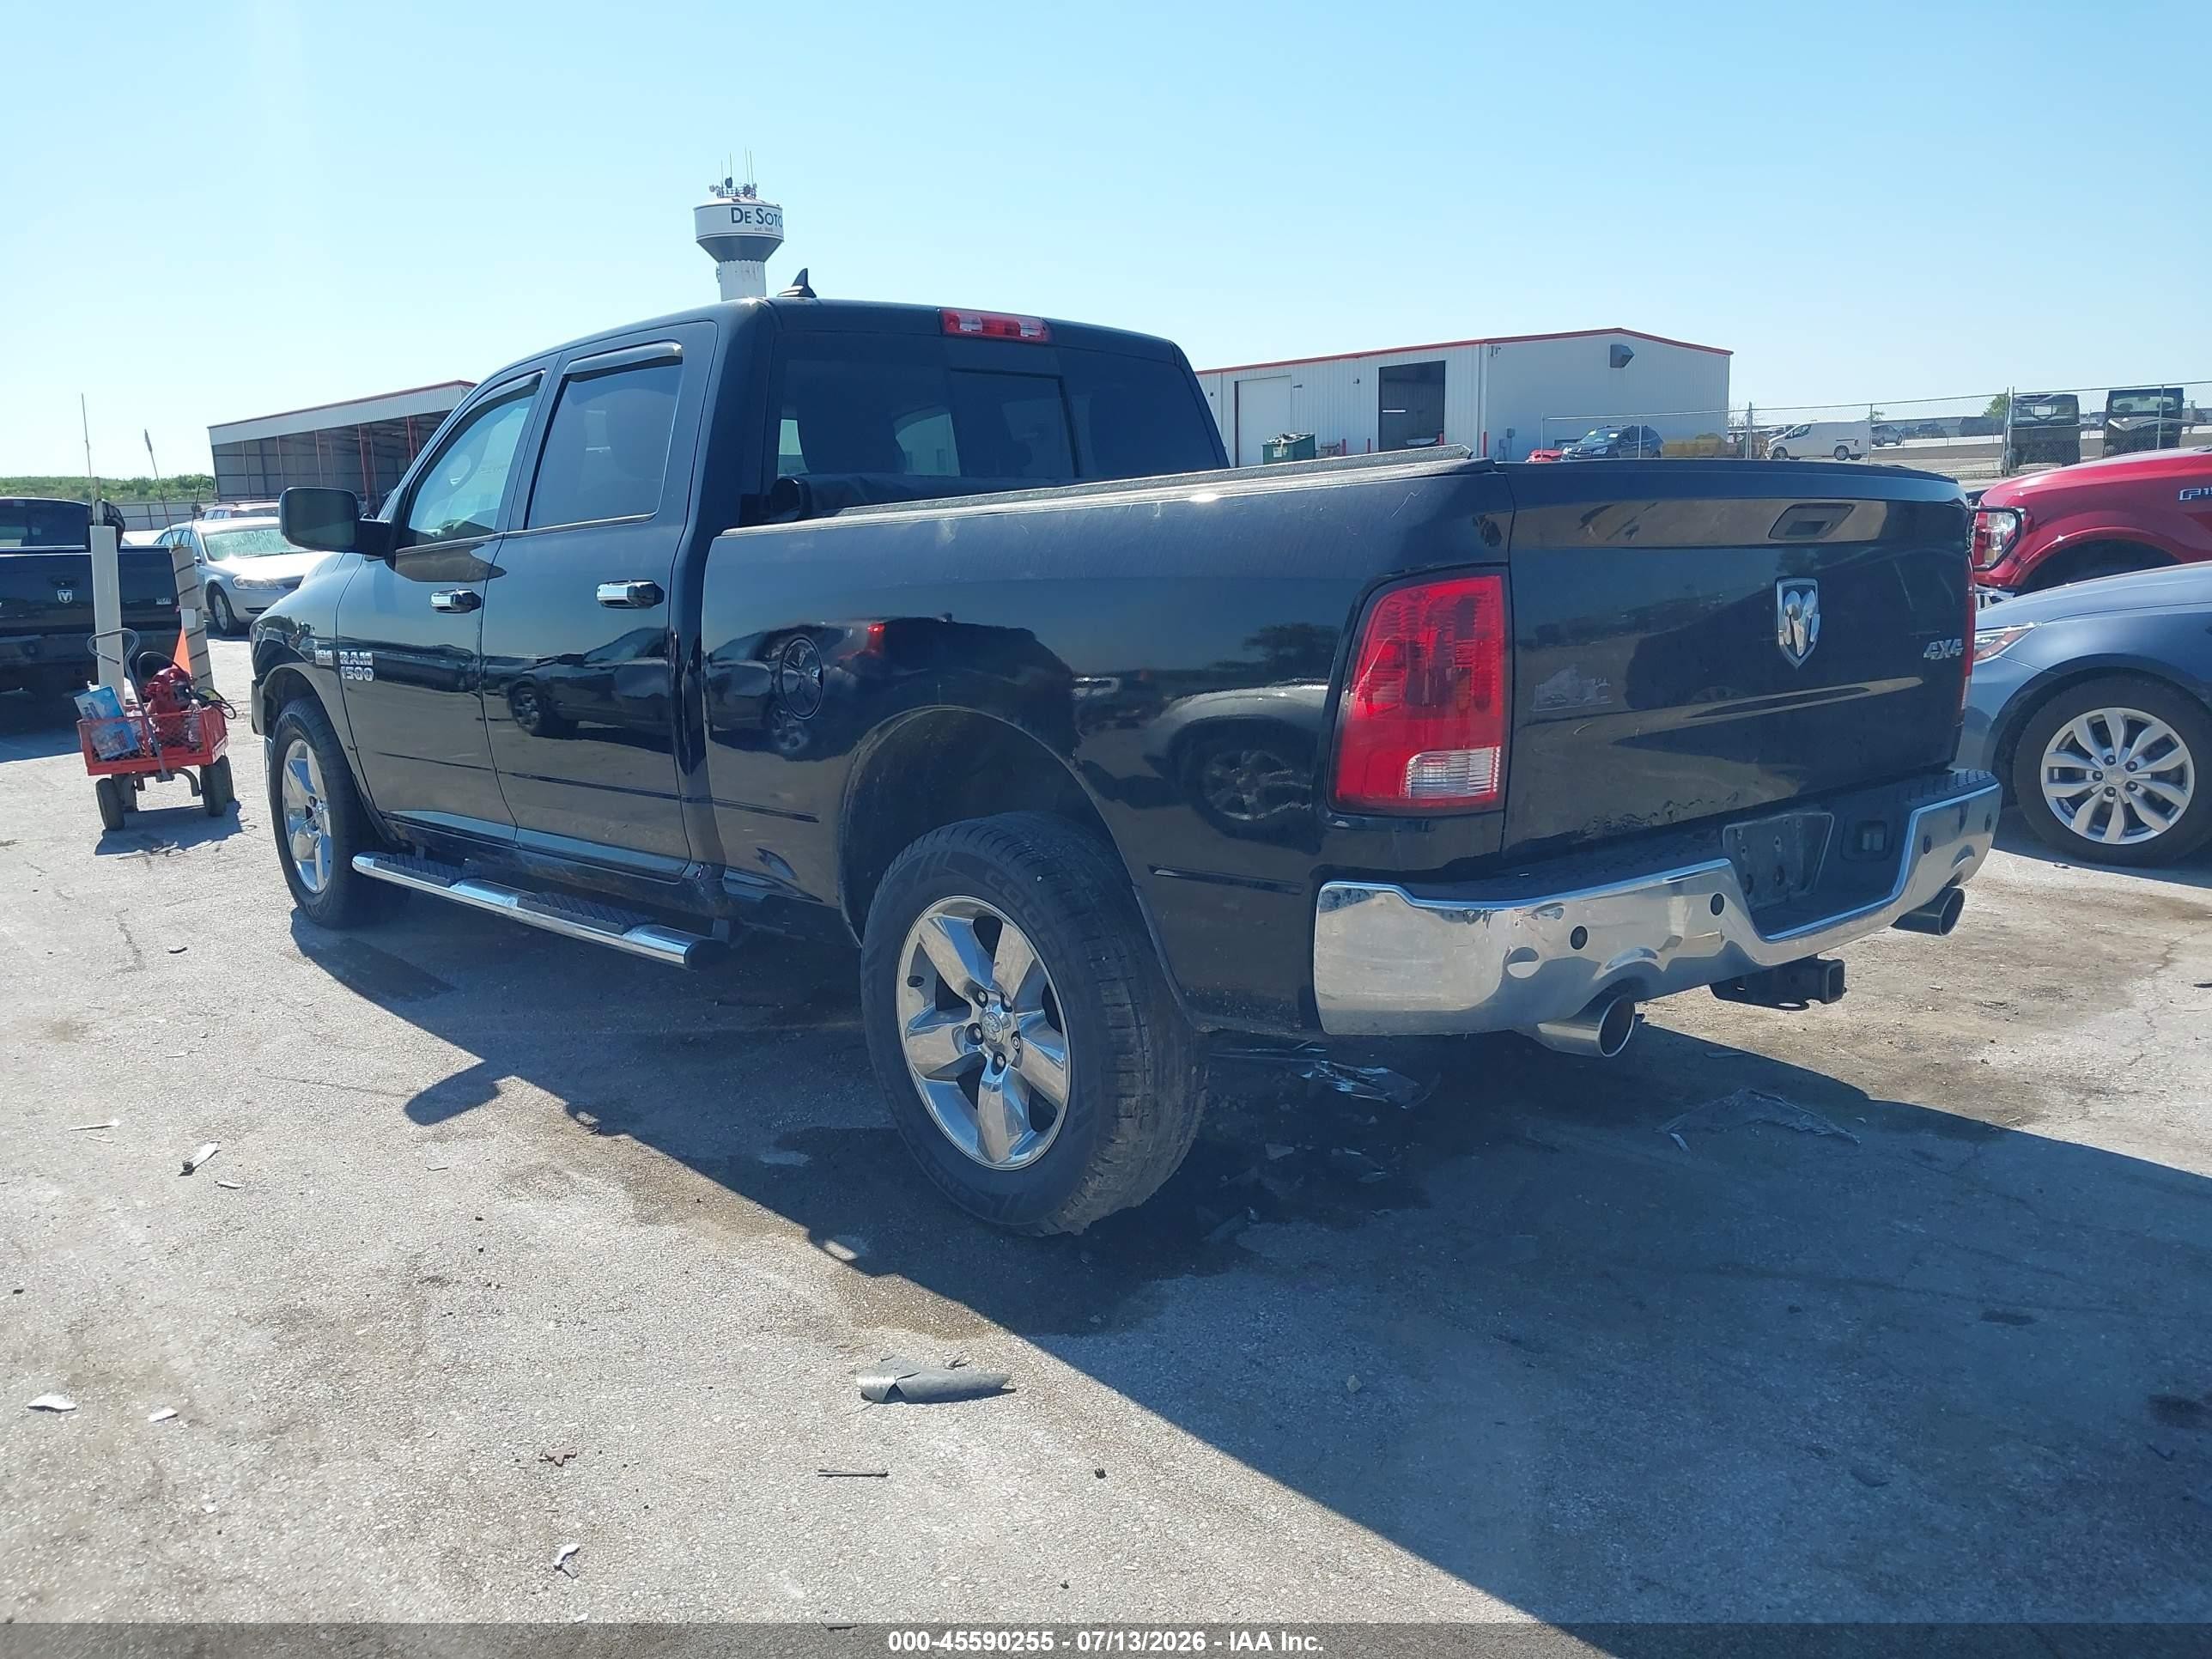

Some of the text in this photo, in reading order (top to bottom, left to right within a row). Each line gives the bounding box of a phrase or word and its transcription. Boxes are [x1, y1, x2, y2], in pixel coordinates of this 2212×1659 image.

[2179, 487, 2212, 501] F1
[339, 651, 374, 666] RAM
[340, 665, 374, 682] 1500
